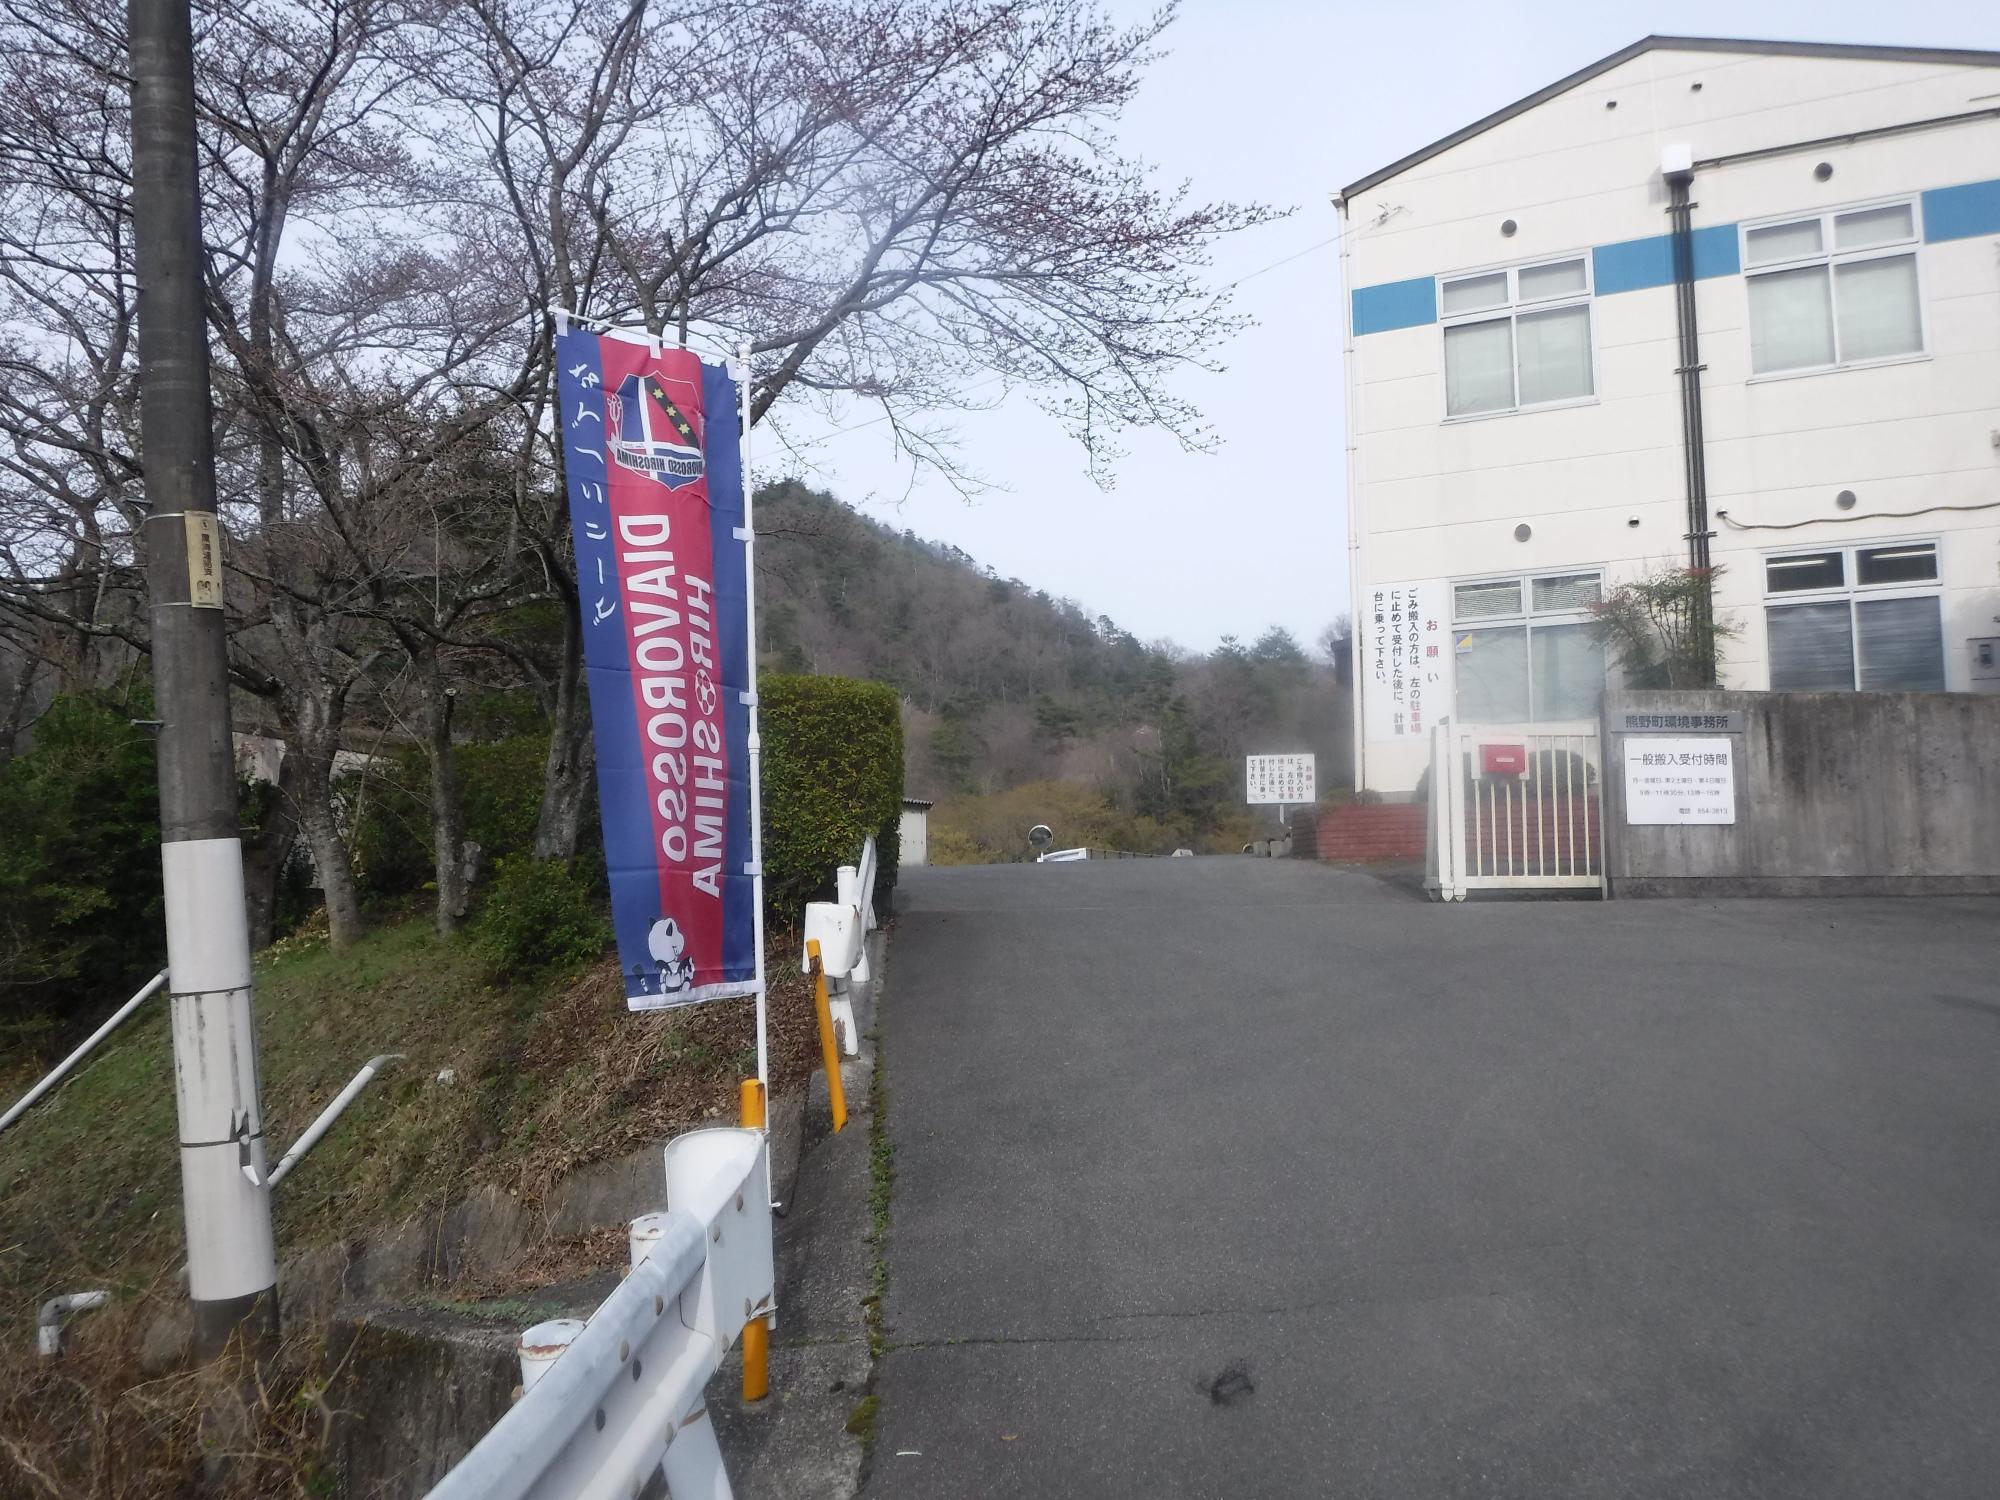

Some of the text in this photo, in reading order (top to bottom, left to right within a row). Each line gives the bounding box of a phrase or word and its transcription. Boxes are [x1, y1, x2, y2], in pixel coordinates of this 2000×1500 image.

[1373, 590, 1387, 685] 台に乗って下さい。
[1425, 619, 1440, 683] お願い
[1625, 715, 1729, 729] 熊野町環境事務所
[1630, 753, 1728, 766] 一般搬入受付時間
